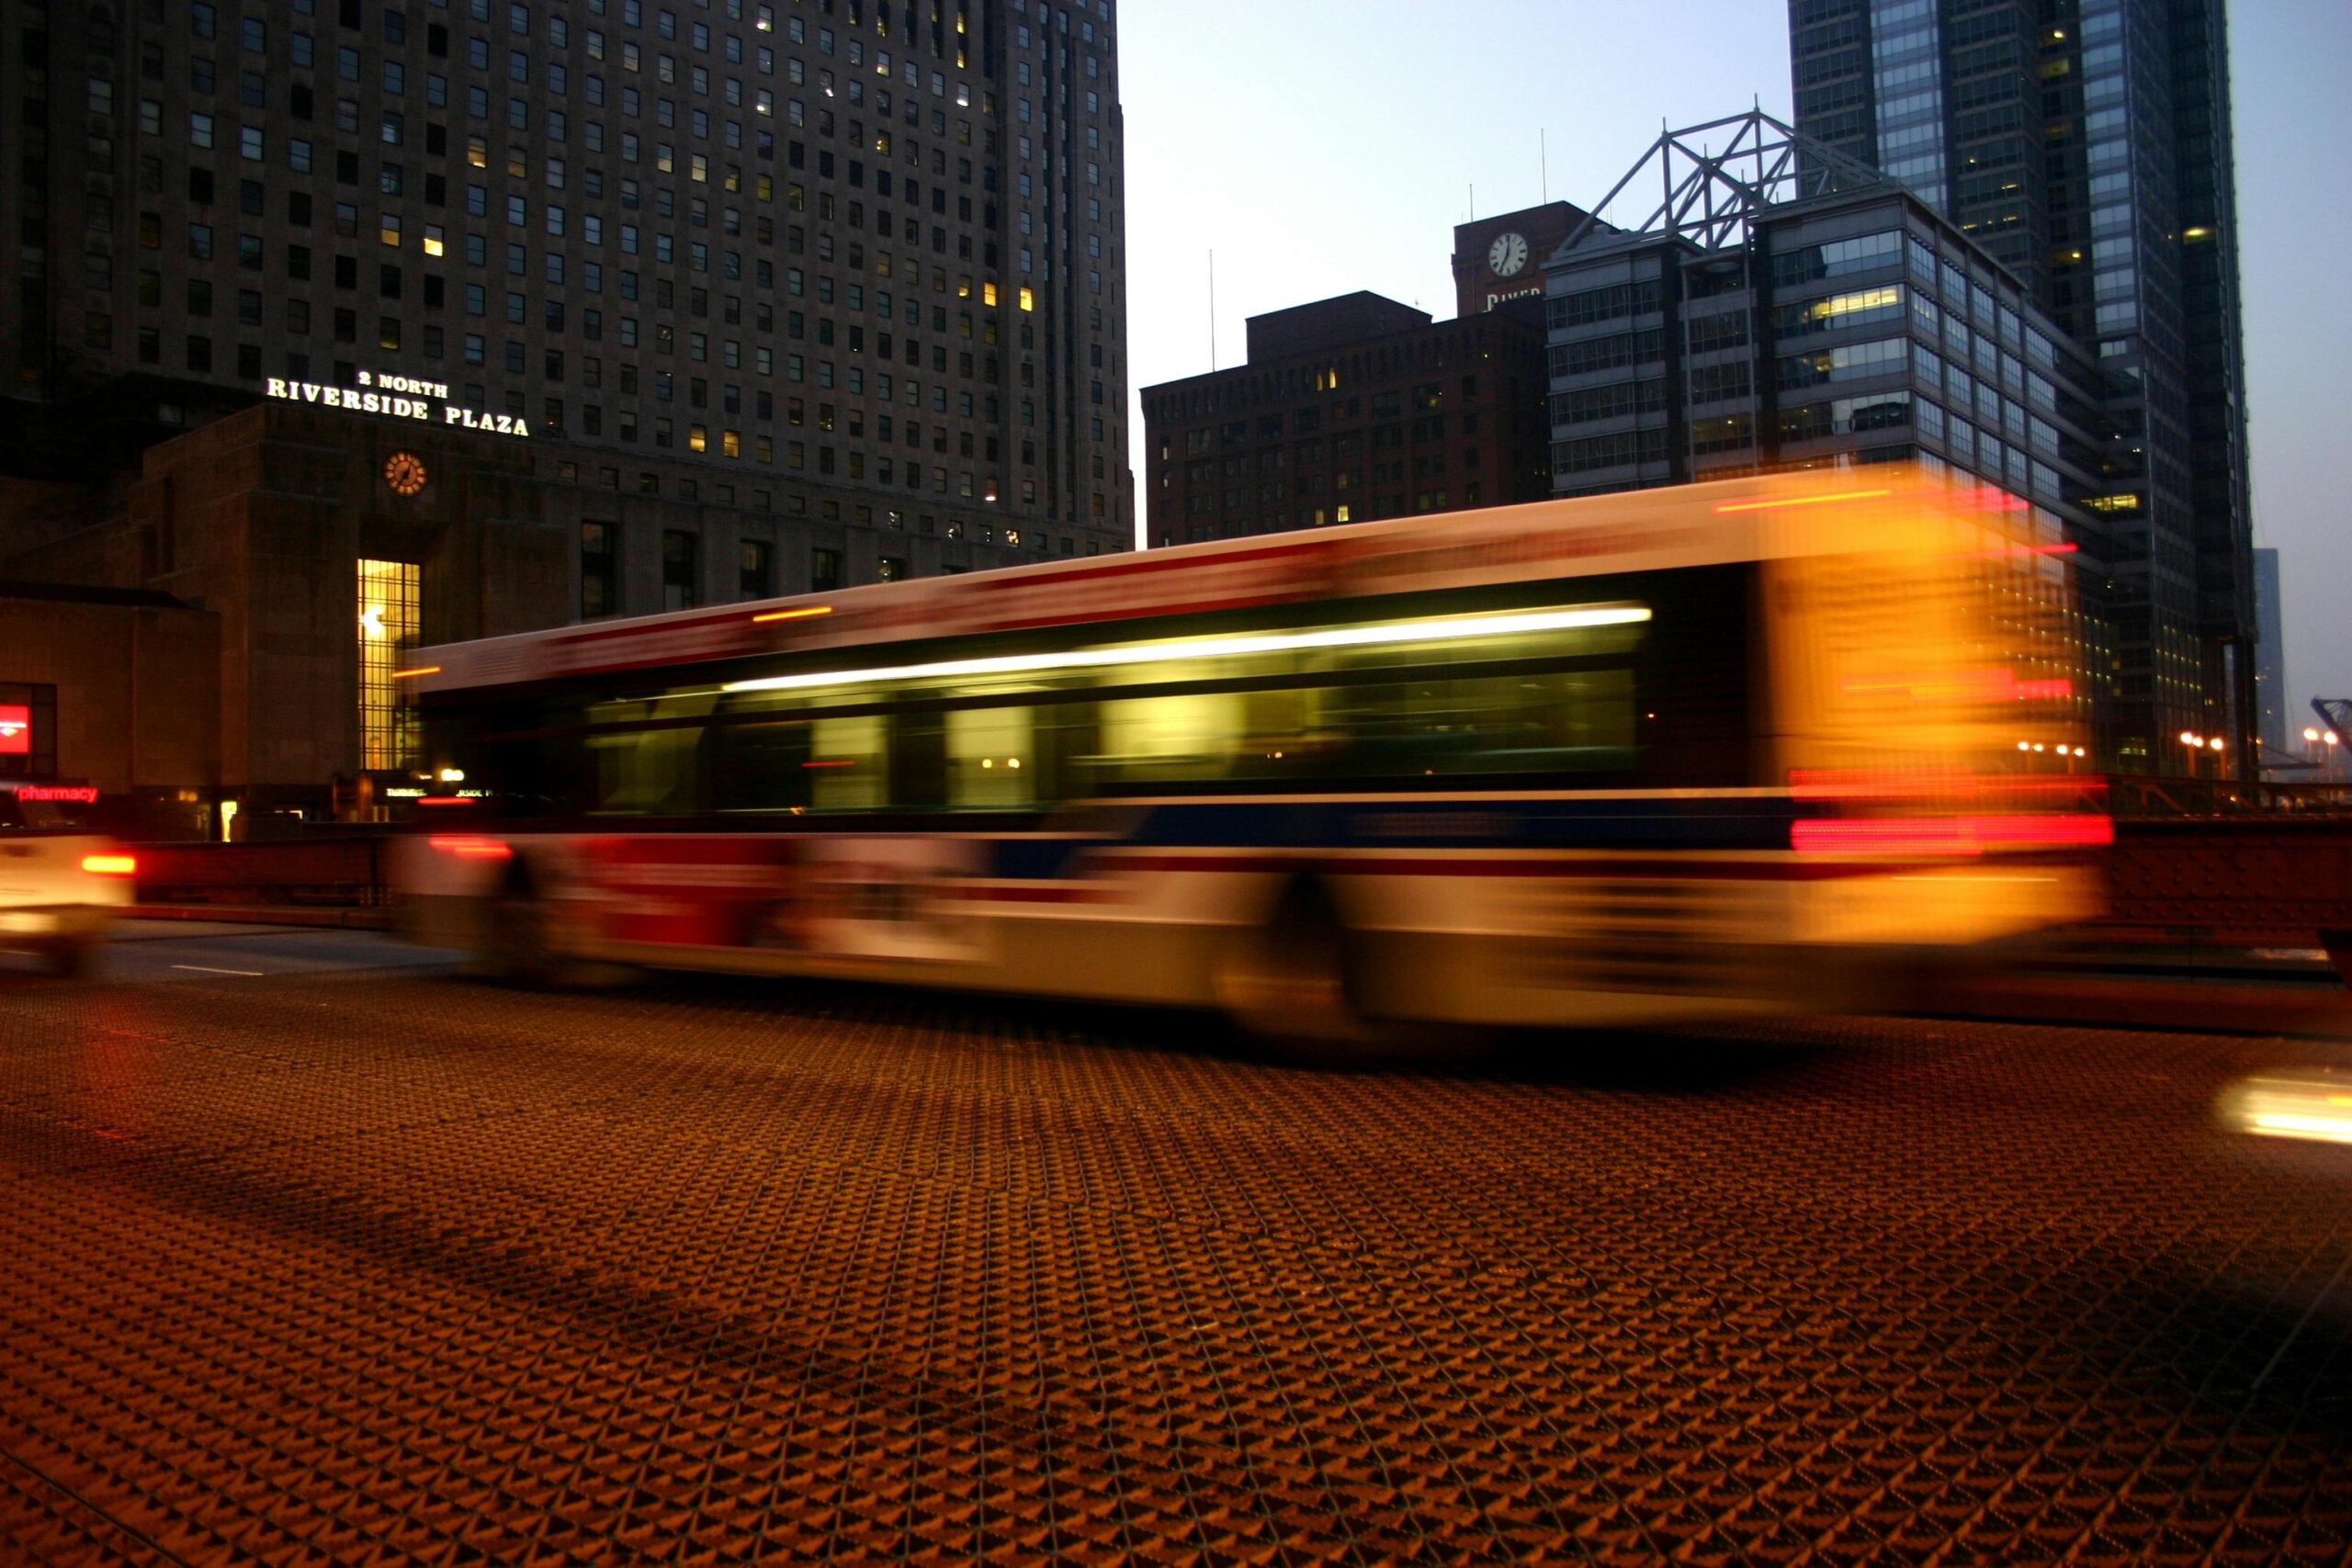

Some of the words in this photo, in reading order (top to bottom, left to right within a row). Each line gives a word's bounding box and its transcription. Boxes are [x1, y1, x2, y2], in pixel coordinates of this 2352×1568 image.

[358, 371, 371, 385] 2
[379, 374, 448, 399] NORTH
[266, 378, 428, 420] RIVERSIDE
[446, 406, 529, 436] PLAZA
